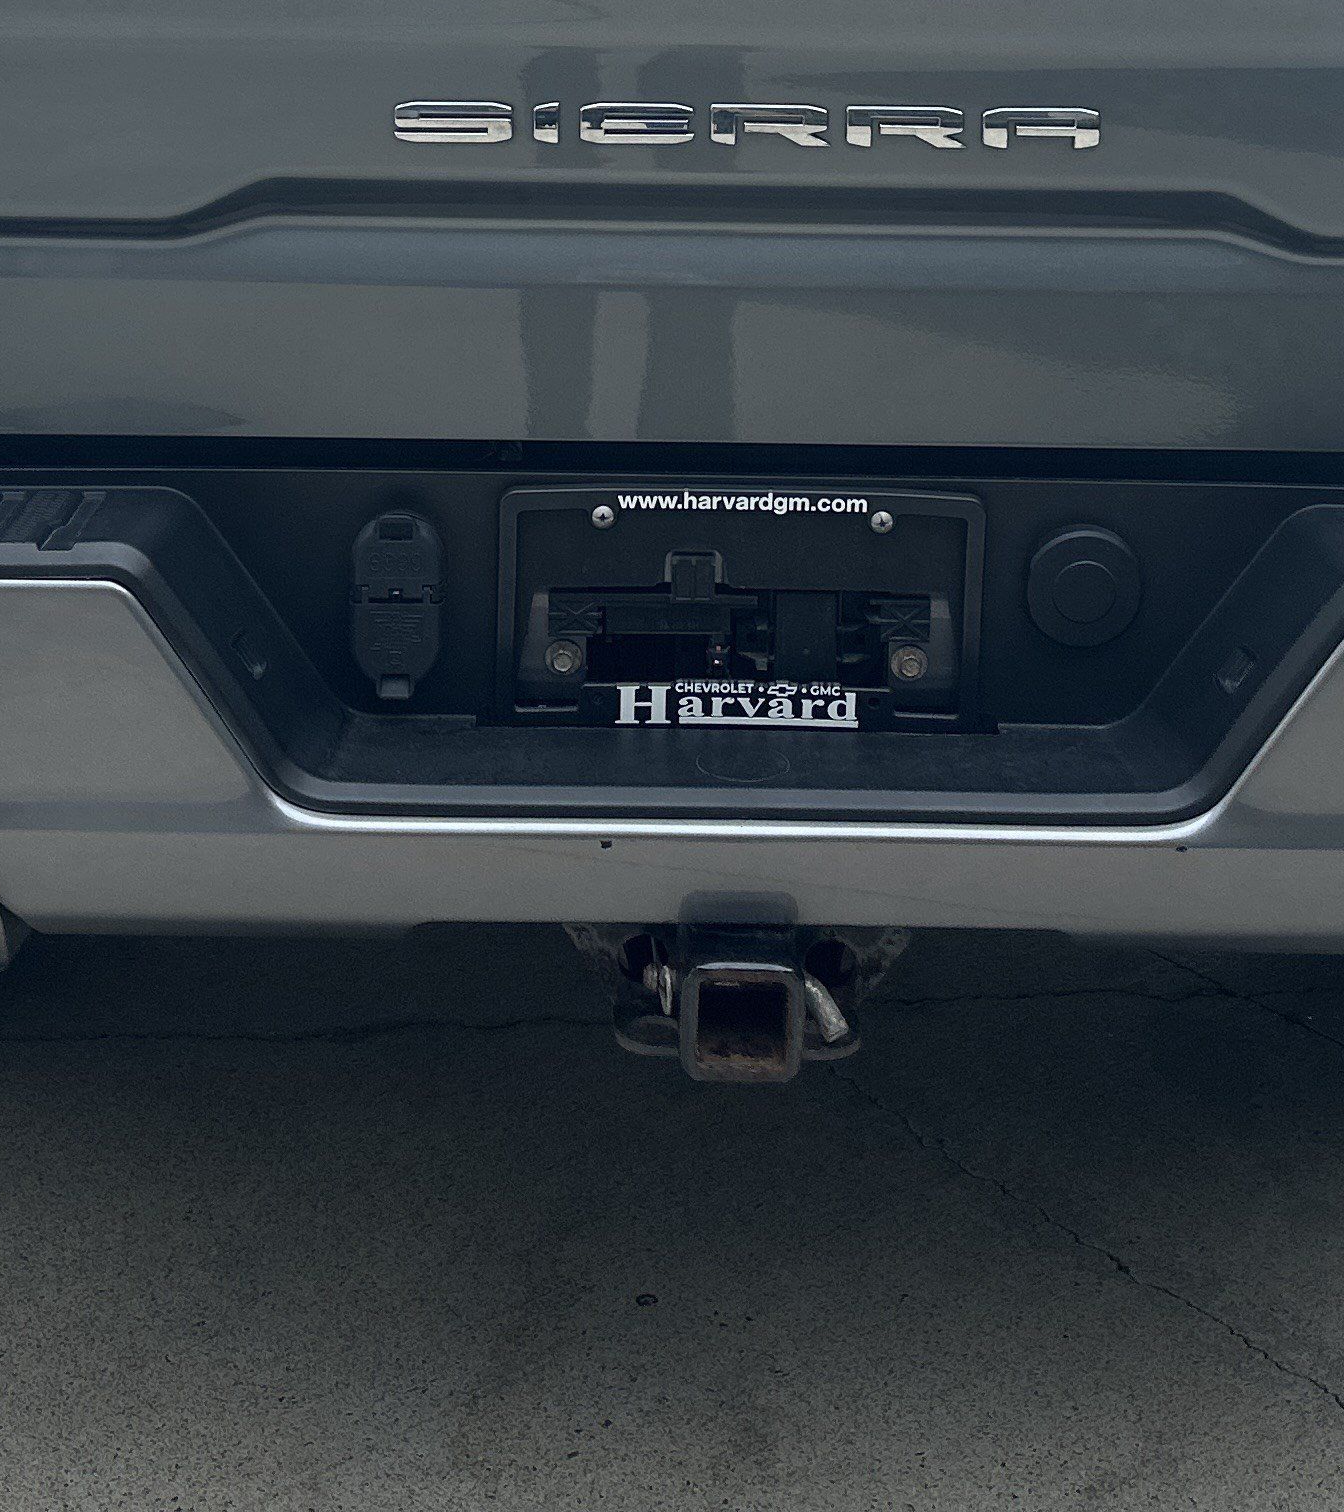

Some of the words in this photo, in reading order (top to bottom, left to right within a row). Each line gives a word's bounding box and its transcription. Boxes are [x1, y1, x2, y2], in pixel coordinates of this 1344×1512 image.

[392, 100, 1102, 150] SIERRA
[617, 491, 869, 515] www.harvardgm.com
[614, 684, 858, 725] Harvard
[674, 682, 755, 694] CHEVROLET
[809, 685, 841, 697] GMC
